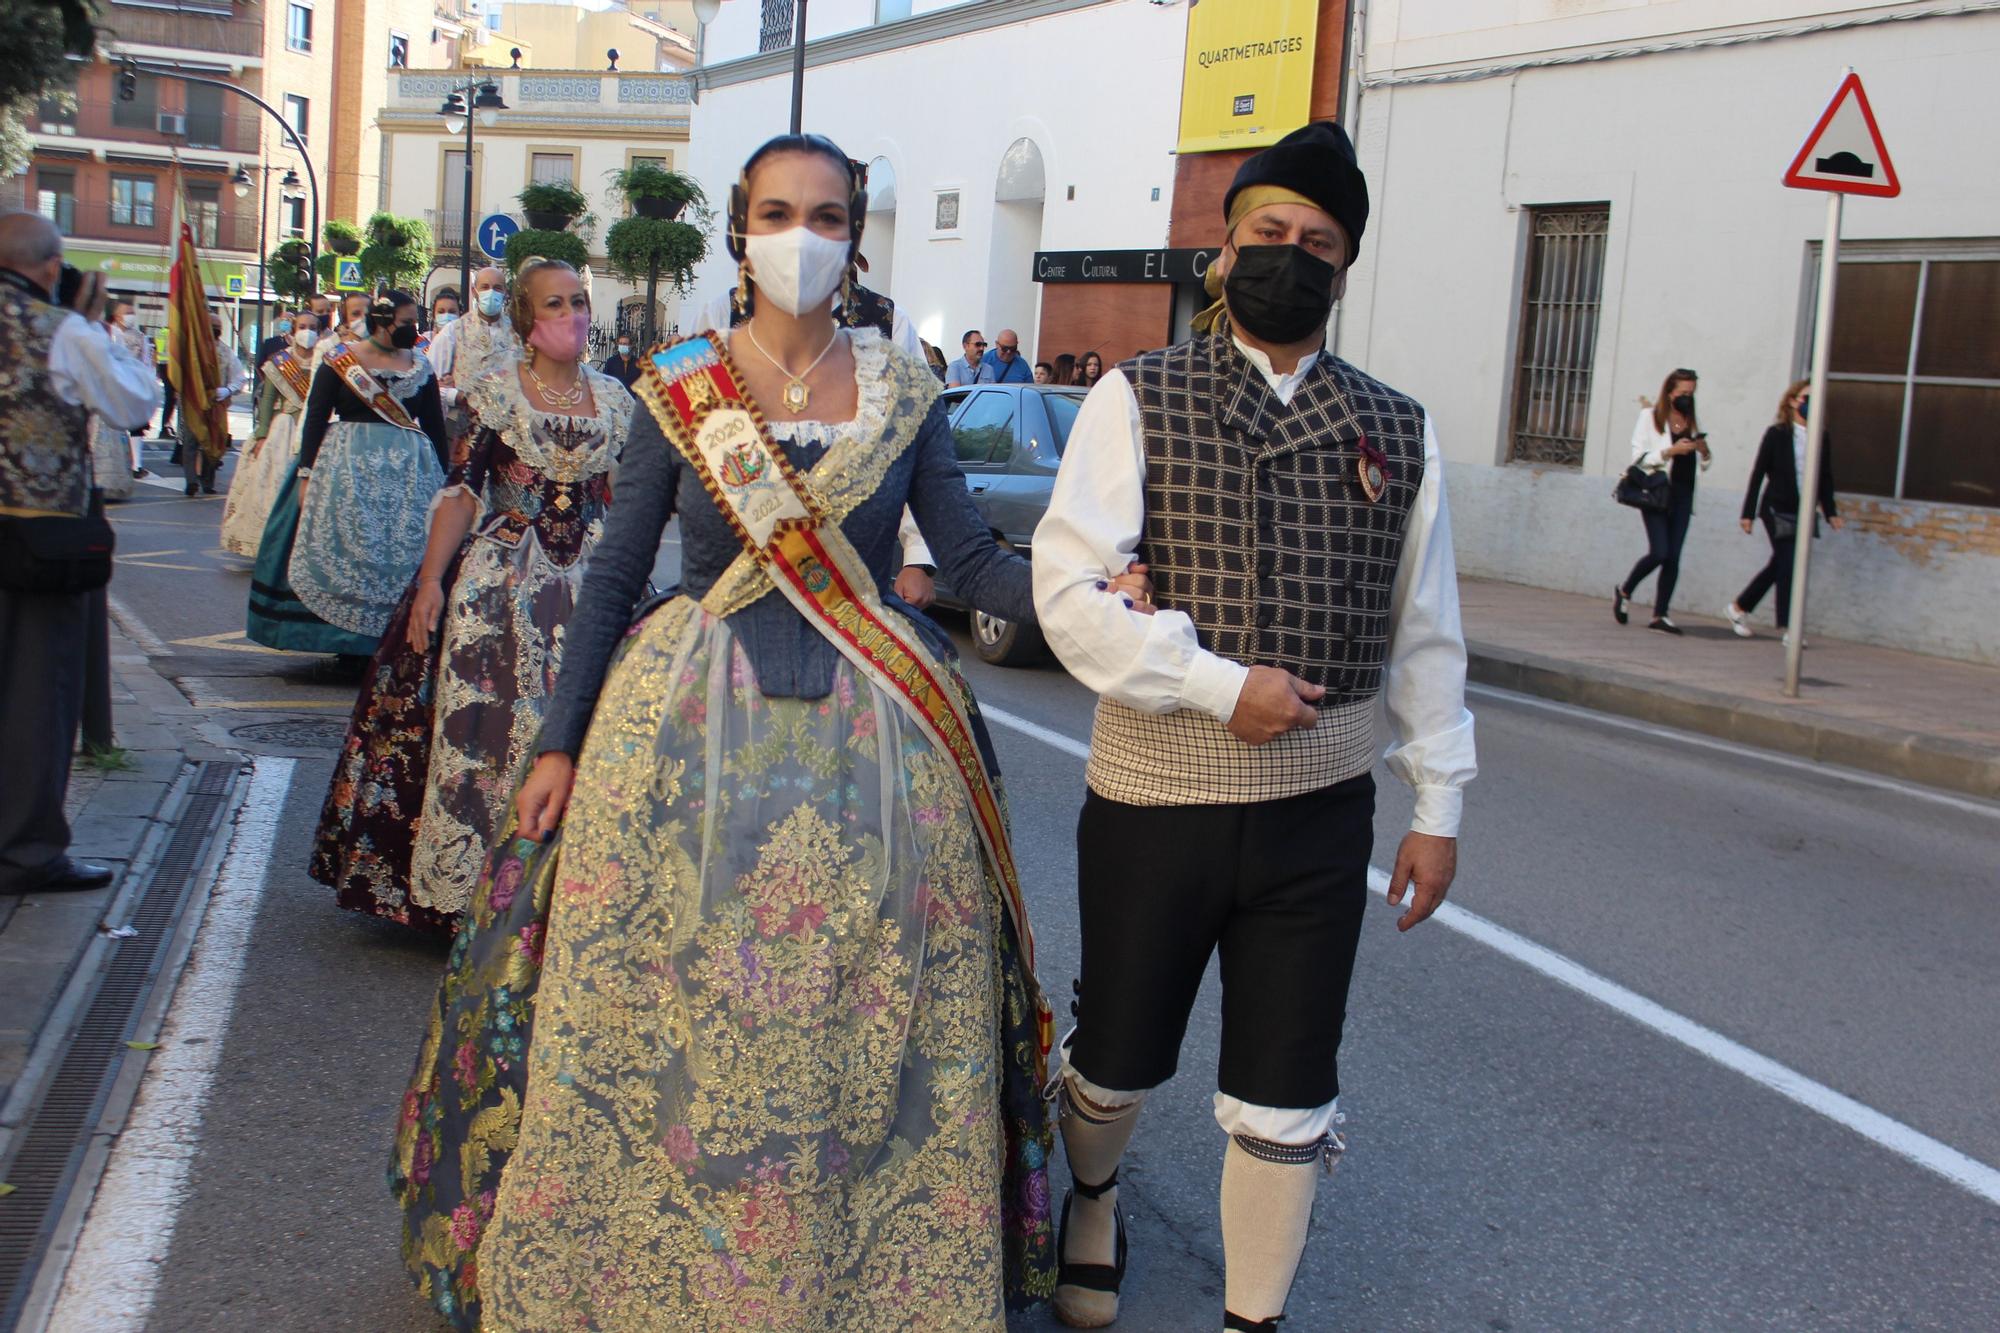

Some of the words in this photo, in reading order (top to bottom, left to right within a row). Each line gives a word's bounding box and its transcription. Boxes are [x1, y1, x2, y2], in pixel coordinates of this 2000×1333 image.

[1198, 37, 1302, 68] QUARTMETRATGES
[1144, 252, 1168, 278] EL
[1192, 251, 1208, 278] C
[705, 417, 745, 451] 2020
[752, 496, 784, 523] 2021
